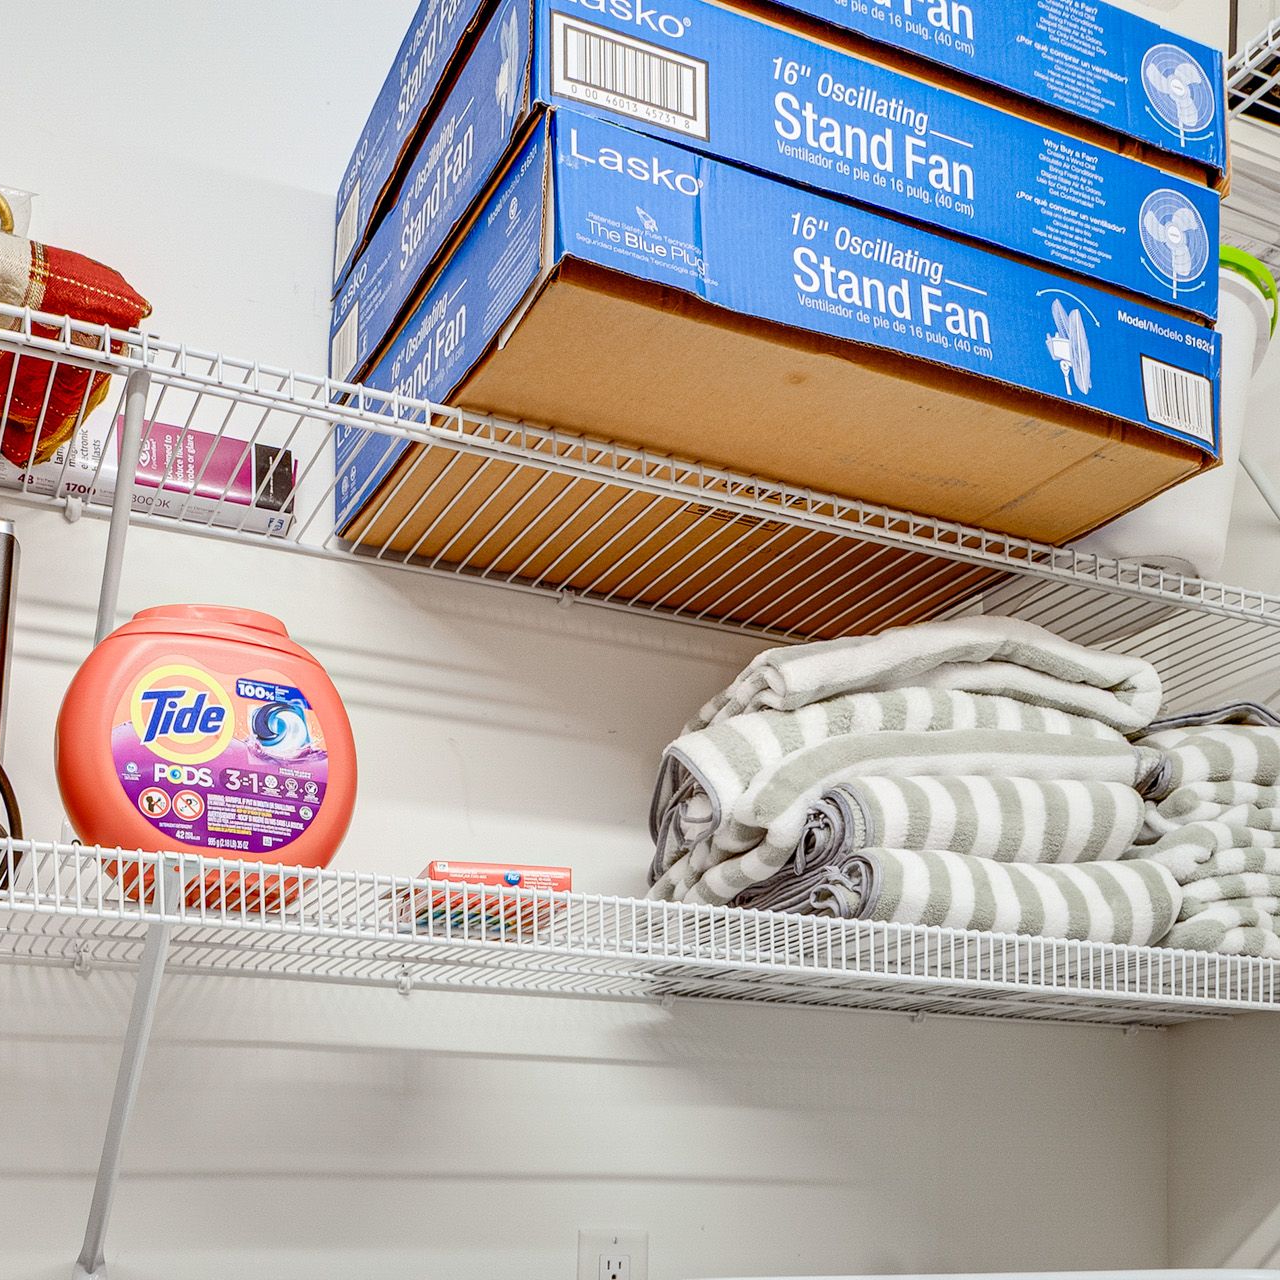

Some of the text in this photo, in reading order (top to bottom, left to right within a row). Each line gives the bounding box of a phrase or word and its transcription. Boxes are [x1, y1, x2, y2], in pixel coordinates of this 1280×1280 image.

[572, 0, 684, 38] asko
[871, 4, 975, 58] de 16 pulg. (40 cm)
[396, 37, 437, 131] Stand
[571, 84, 690, 129] 0 00 46013 45731 8
[772, 56, 929, 136] 16" Oscillating
[338, 138, 369, 209] Lasko
[414, 114, 456, 197] Oscillating
[570, 127, 702, 197] Lasko
[773, 91, 974, 201] Stand Fan
[776, 140, 975, 219] Ventilador de pie de 16 pulg. (40 cm)
[399, 124, 475, 271] Stand Fan
[585, 217, 706, 275] The Blue Plug
[791, 211, 944, 286] 16" Oscillating
[332, 266, 368, 327] Lasko
[405, 292, 448, 360] Oscillating
[792, 246, 991, 344] Stand Fan
[797, 292, 993, 361] Ventilador de pie de 16 pulg. (40 cm)
[1117, 310, 1184, 343] Model/Modelo
[433, 303, 467, 378] Fan
[164, 434, 173, 443] to
[185, 434, 196, 462] or glare
[65, 482, 96, 496] 1700
[140, 689, 226, 744] Tide
[238, 683, 275, 701] 100%
[175, 830, 185, 839] 42
